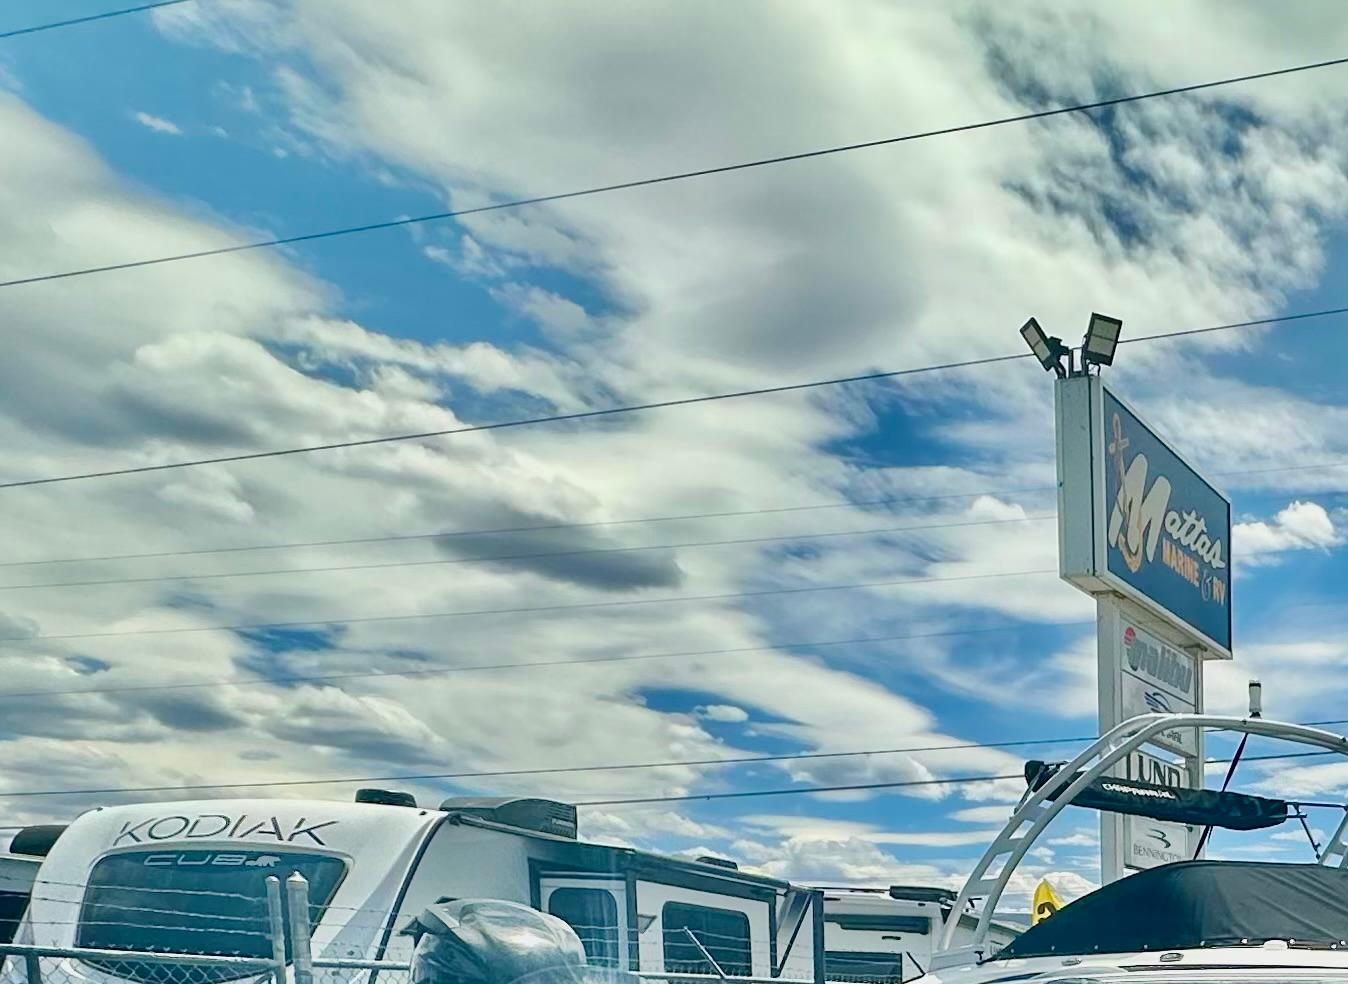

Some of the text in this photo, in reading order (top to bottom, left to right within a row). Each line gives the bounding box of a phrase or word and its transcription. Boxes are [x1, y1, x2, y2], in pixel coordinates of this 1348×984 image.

[1108, 453, 1226, 570] Mattas
[1162, 536, 1199, 588] MARINE
[112, 814, 340, 846] KODIAK
[143, 853, 247, 866] CUB
[1133, 843, 1182, 862] BENNINGTO
